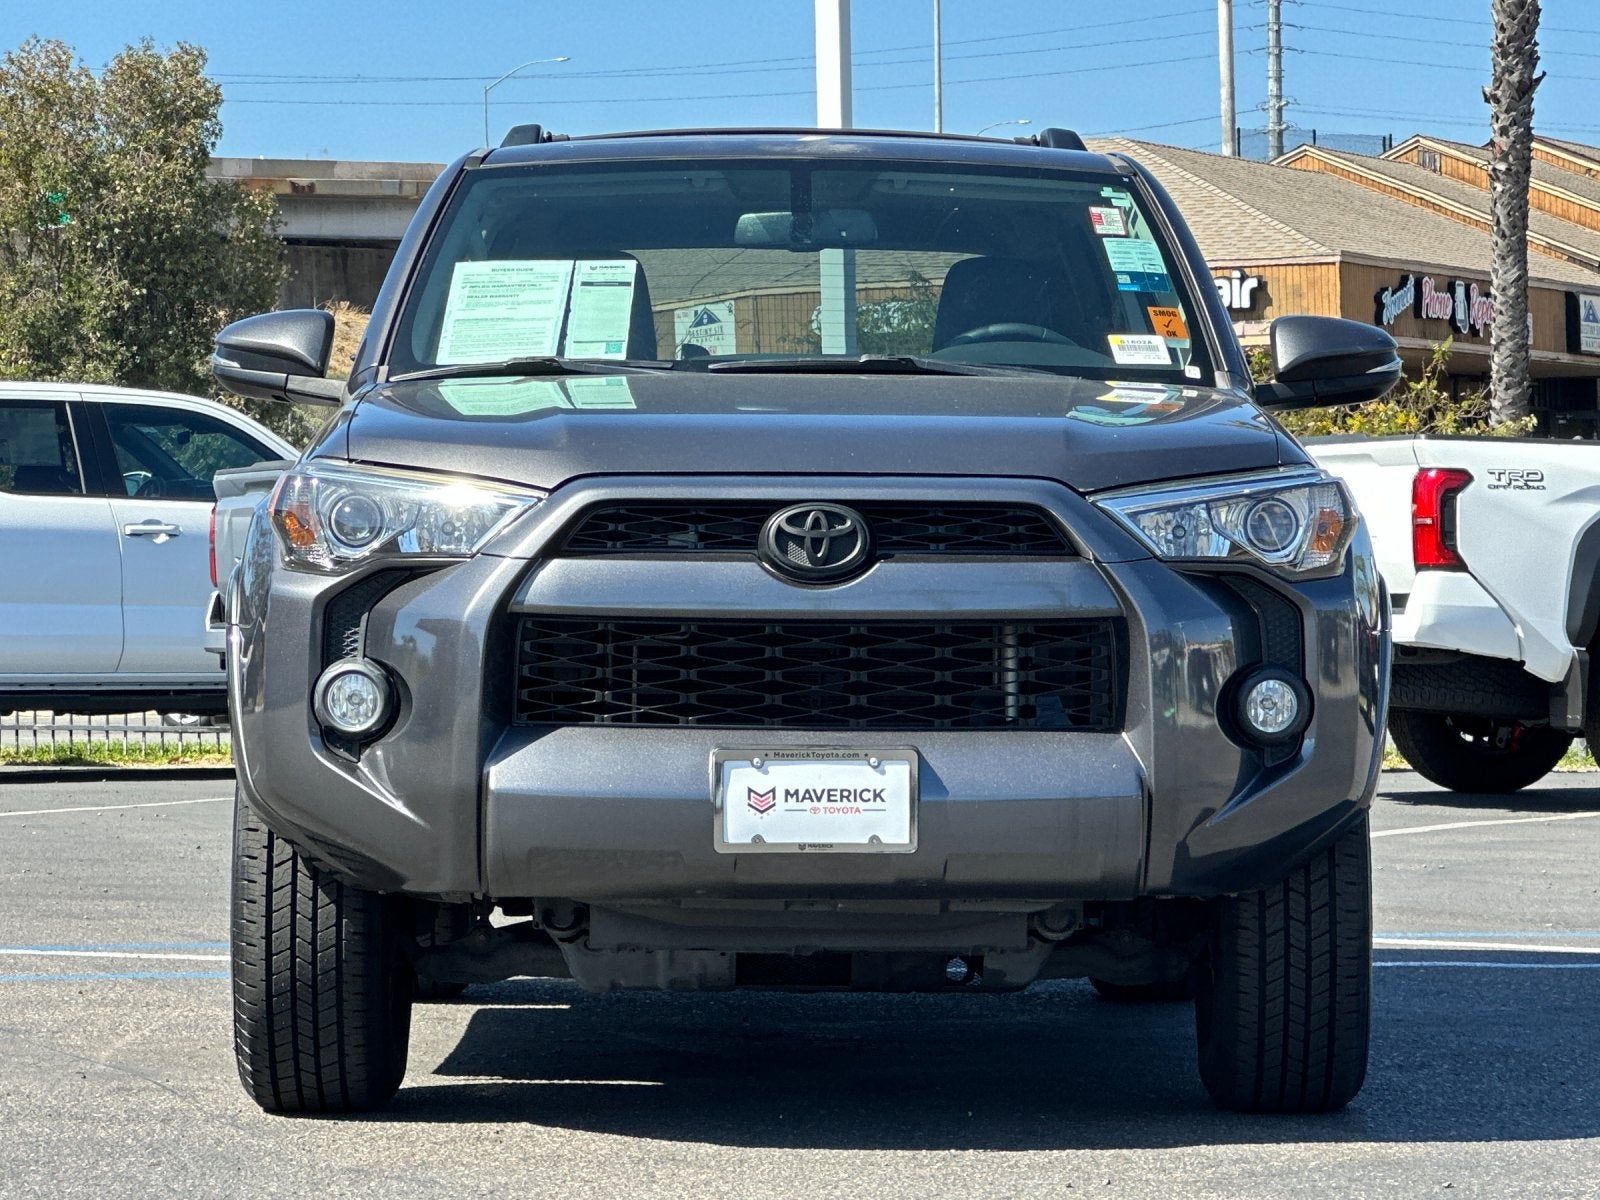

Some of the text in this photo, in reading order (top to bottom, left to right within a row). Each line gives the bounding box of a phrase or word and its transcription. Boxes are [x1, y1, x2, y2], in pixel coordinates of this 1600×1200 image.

[1214, 270, 1258, 309] air
[1153, 309, 1178, 317] SMOG
[1422, 276, 1453, 320] Phone
[1469, 283, 1495, 338] Repa
[1487, 469, 1544, 486] TRD
[773, 751, 860, 760] MaverickToyota.com
[784, 788, 886, 803] MAVERICK
[823, 806, 862, 815] TOYOTA
